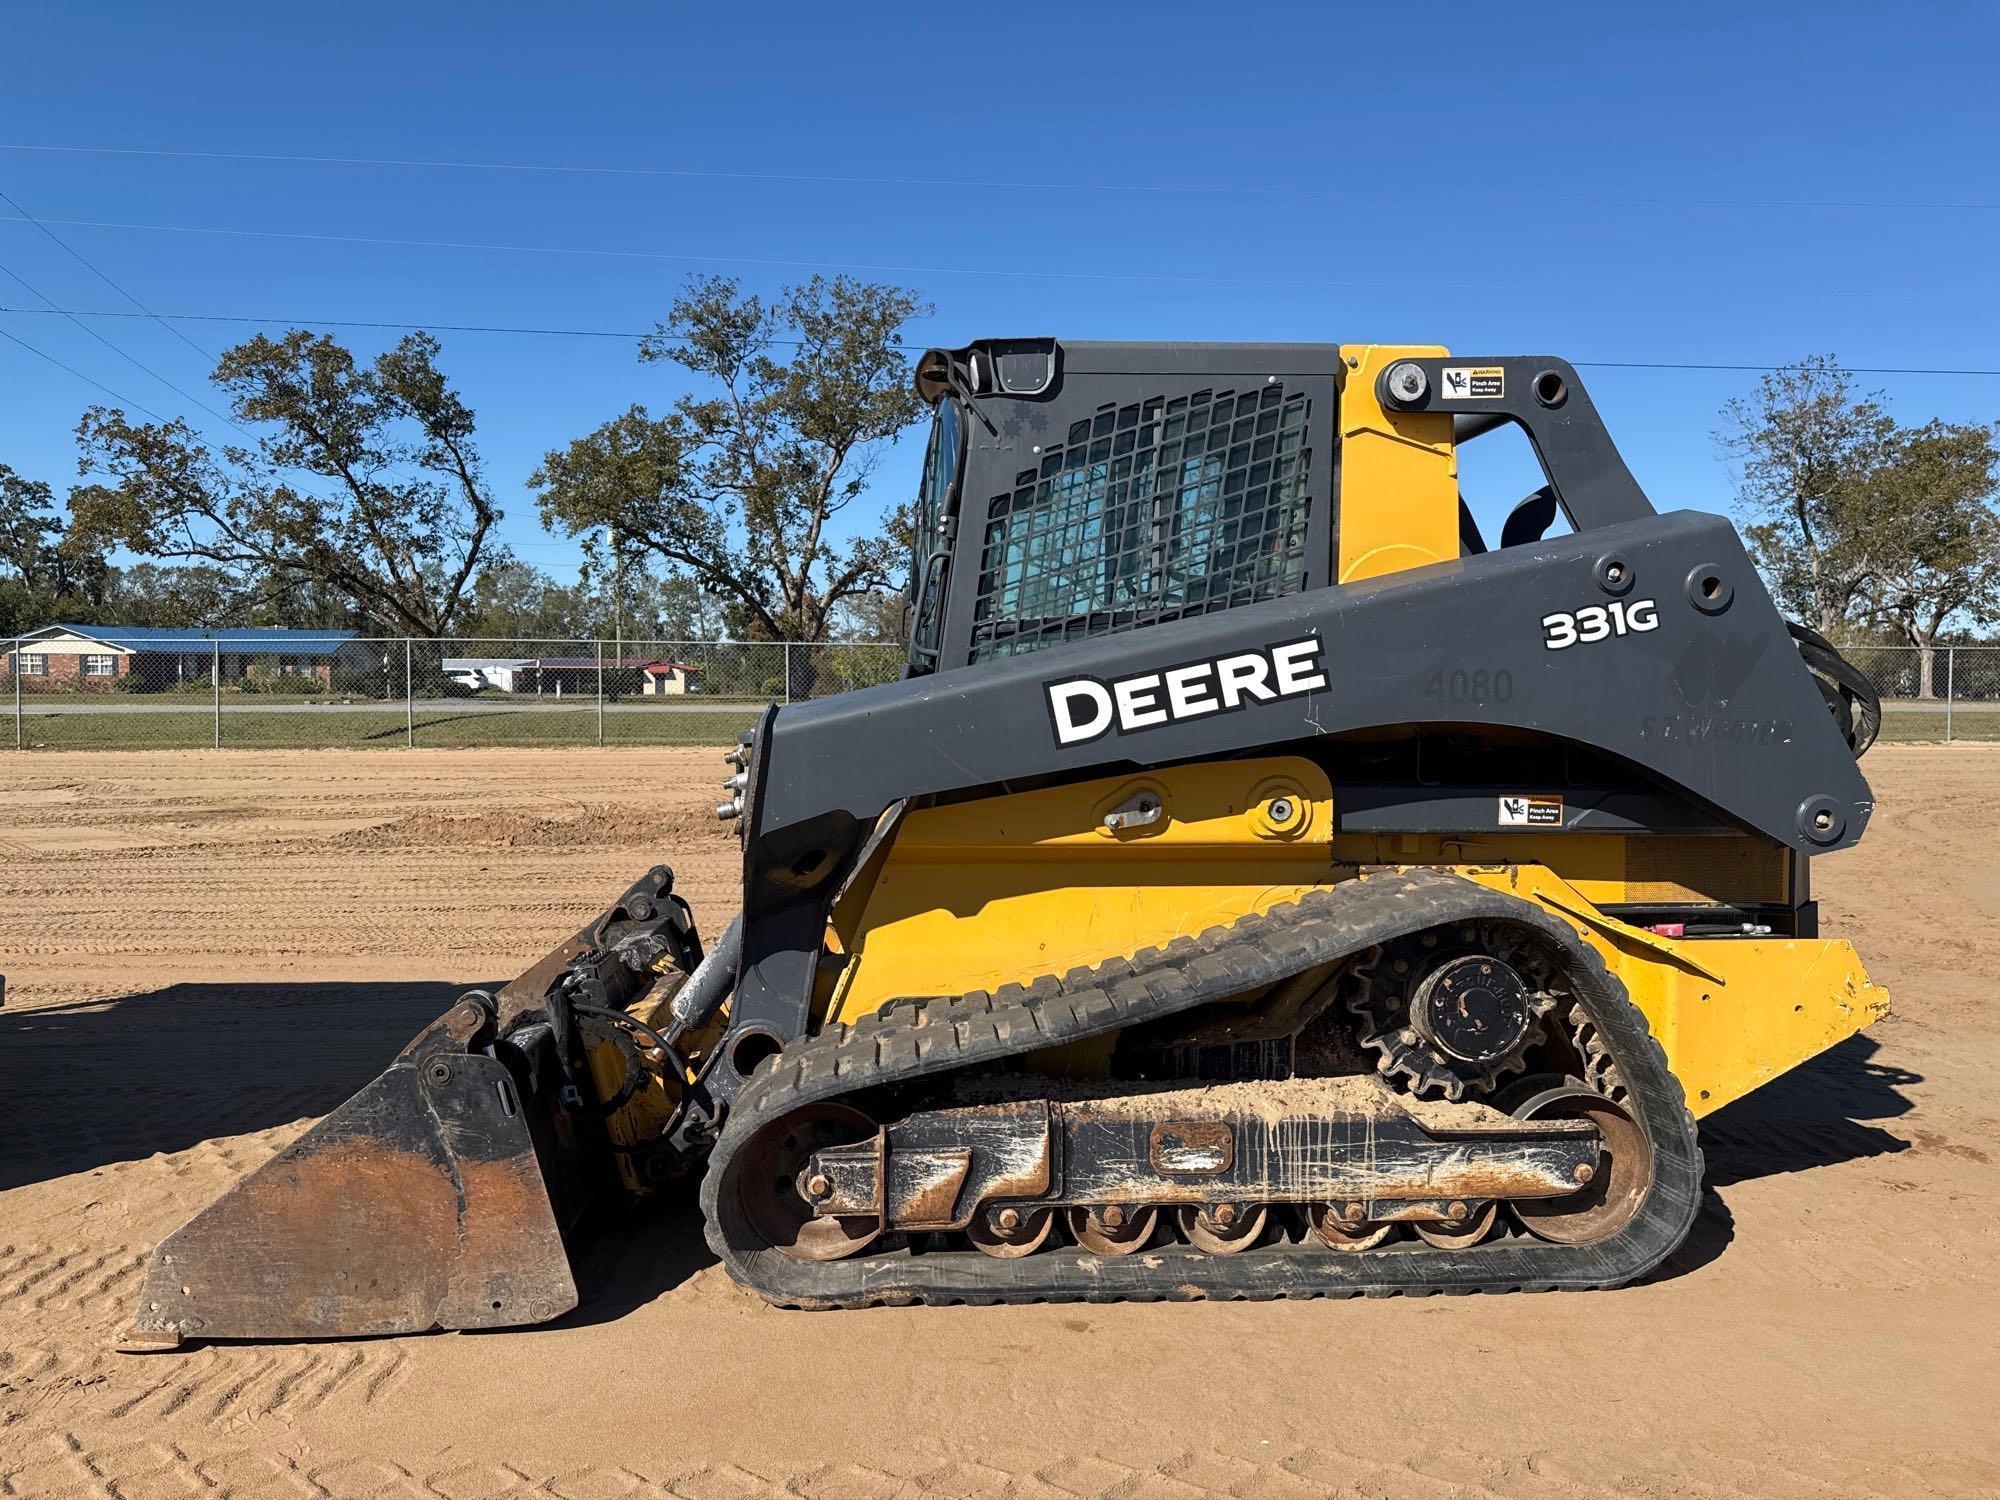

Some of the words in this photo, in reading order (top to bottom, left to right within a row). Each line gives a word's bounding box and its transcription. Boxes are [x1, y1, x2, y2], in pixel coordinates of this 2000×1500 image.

[1543, 599, 1659, 650] 331G
[1048, 638, 1327, 745] DEERE
[1424, 668, 1513, 704] 4080
